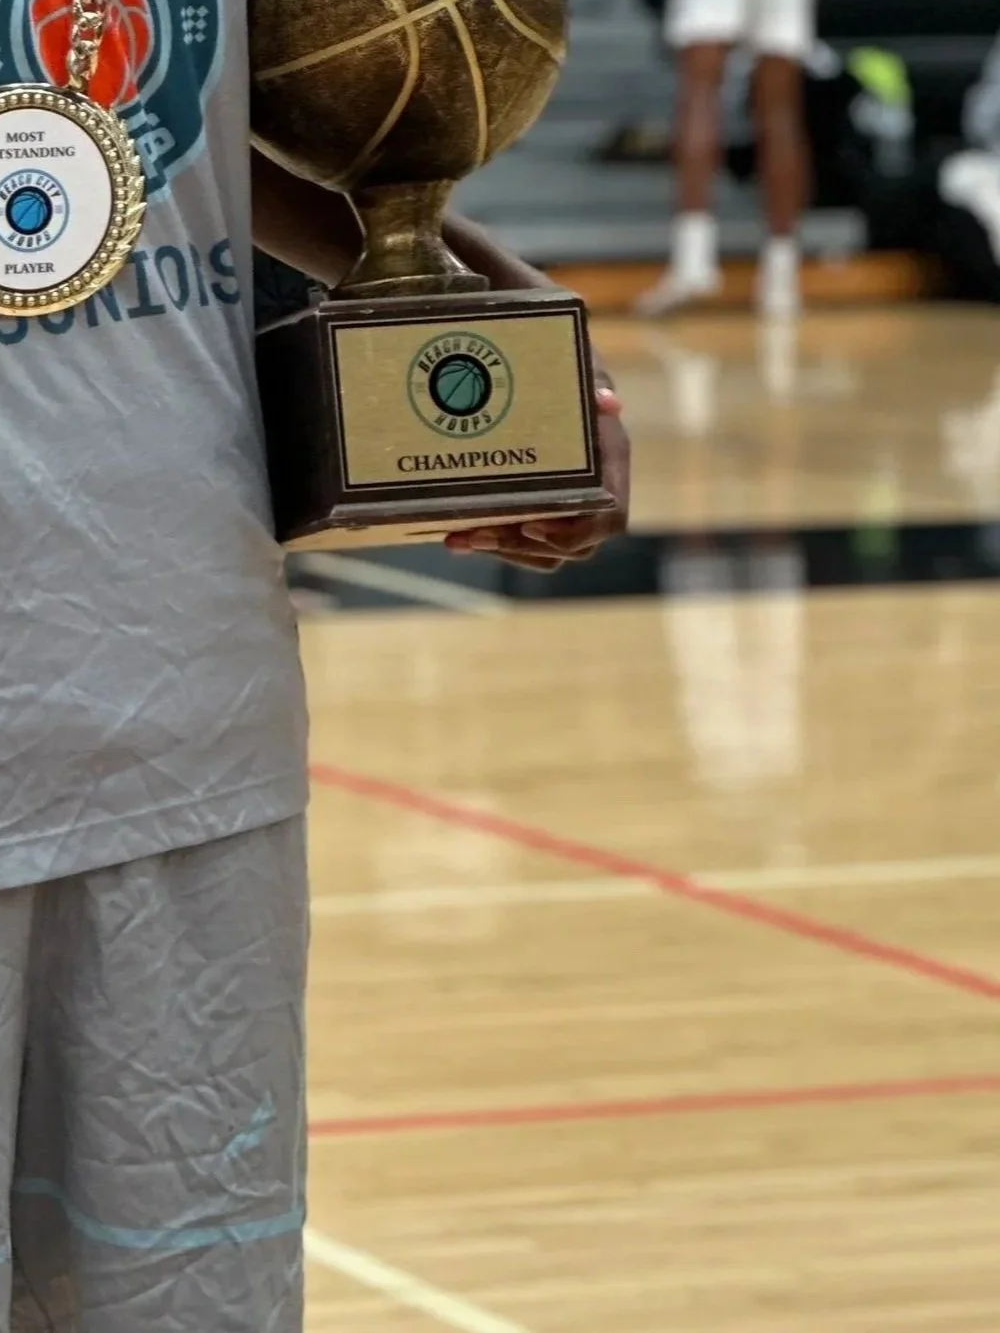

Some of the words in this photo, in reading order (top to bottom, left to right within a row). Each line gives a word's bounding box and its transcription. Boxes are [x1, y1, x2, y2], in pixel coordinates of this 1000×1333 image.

[5, 130, 46, 144] MOST
[35, 175, 61, 197] CITY
[4, 261, 56, 275] PLAYER
[417, 338, 462, 374] BEACH
[466, 339, 502, 368] CITY
[434, 409, 493, 433] HOOPS
[397, 447, 537, 473] CHAMPIONS
